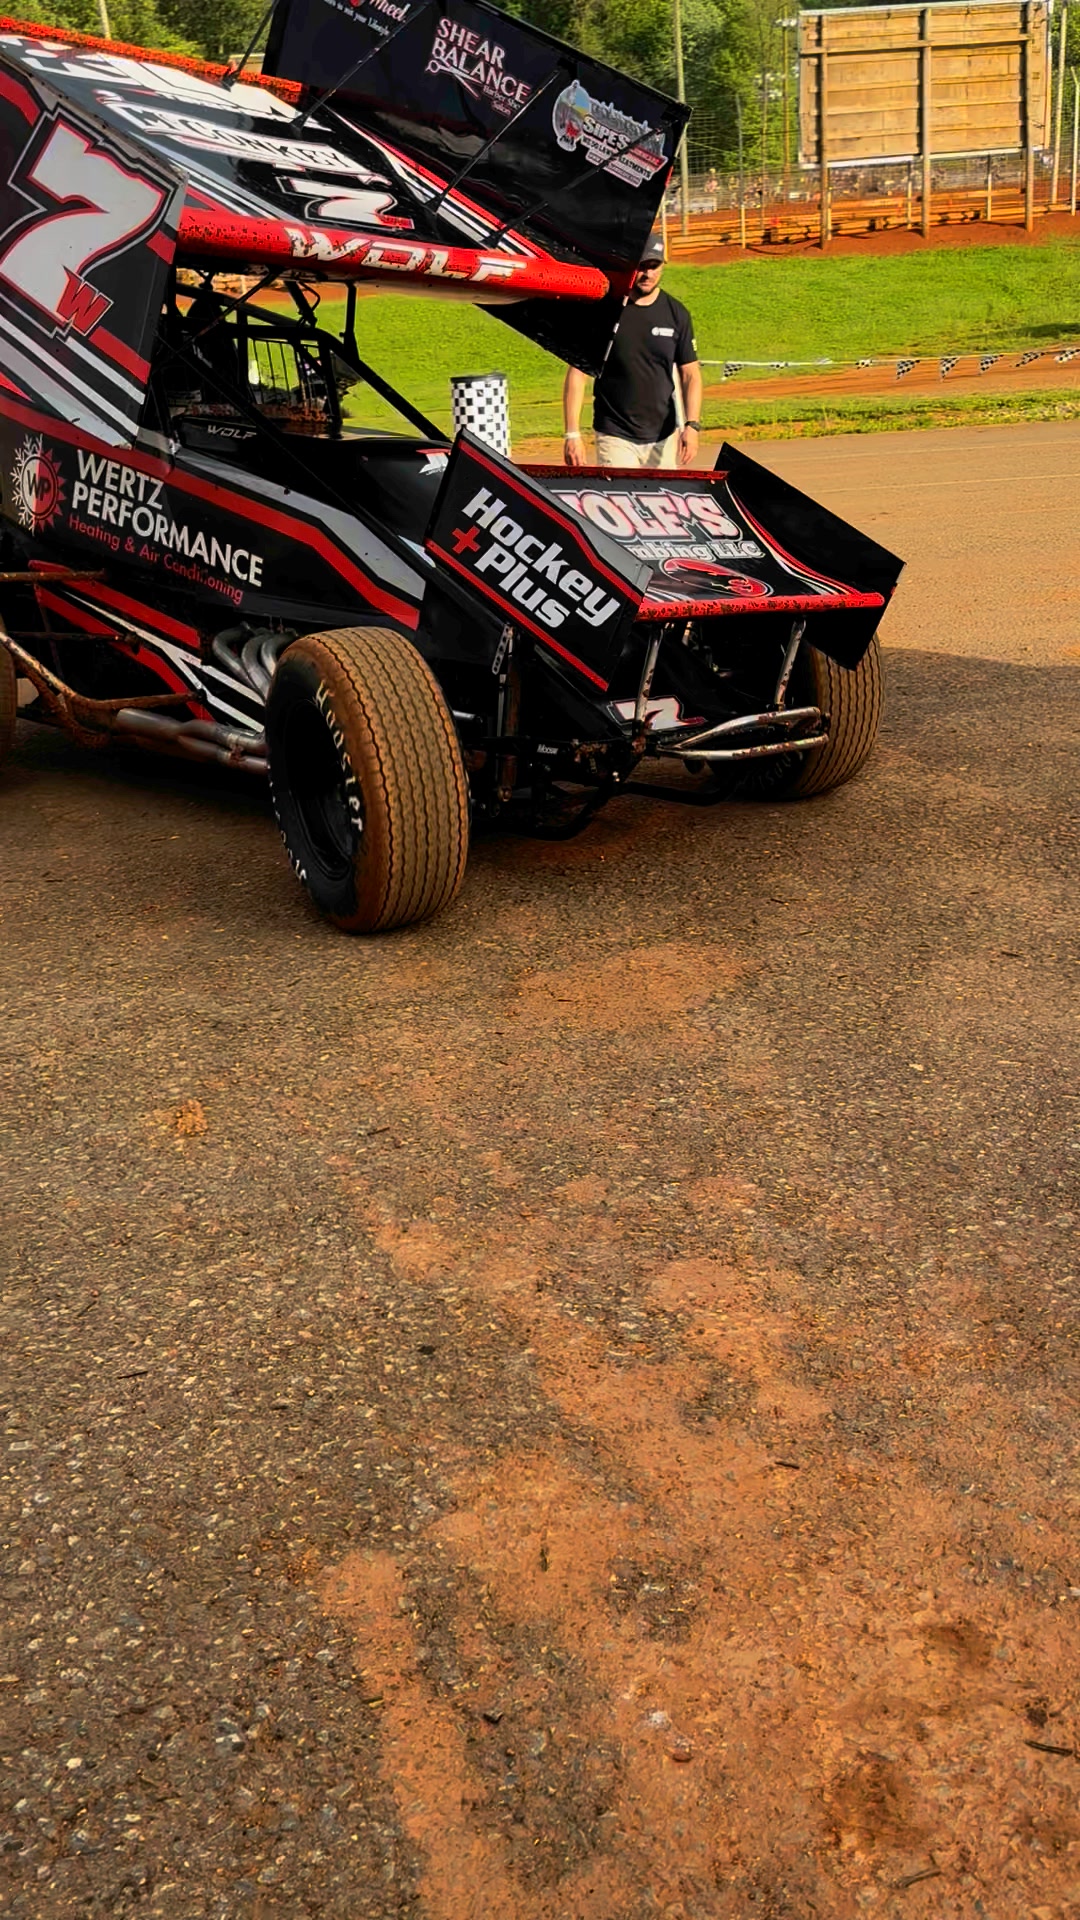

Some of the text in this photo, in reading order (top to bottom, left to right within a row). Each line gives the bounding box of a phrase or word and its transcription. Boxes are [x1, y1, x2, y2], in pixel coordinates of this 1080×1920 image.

[432, 37, 531, 104] BALANCE
[437, 18, 505, 69] SHEAR
[0, 118, 168, 330] 7
[284, 226, 527, 282] WOLF
[56, 264, 113, 336] W
[207, 424, 257, 440] WOLF
[26, 469, 50, 501] WP
[77, 449, 164, 510] WERTZ
[68, 513, 244, 604] Heating & Air Conditioning
[72, 480, 264, 588] PERFORMANCE
[461, 487, 621, 627] Hockey
[628, 542, 763, 561] mbing LLC
[474, 542, 570, 628] Plus
